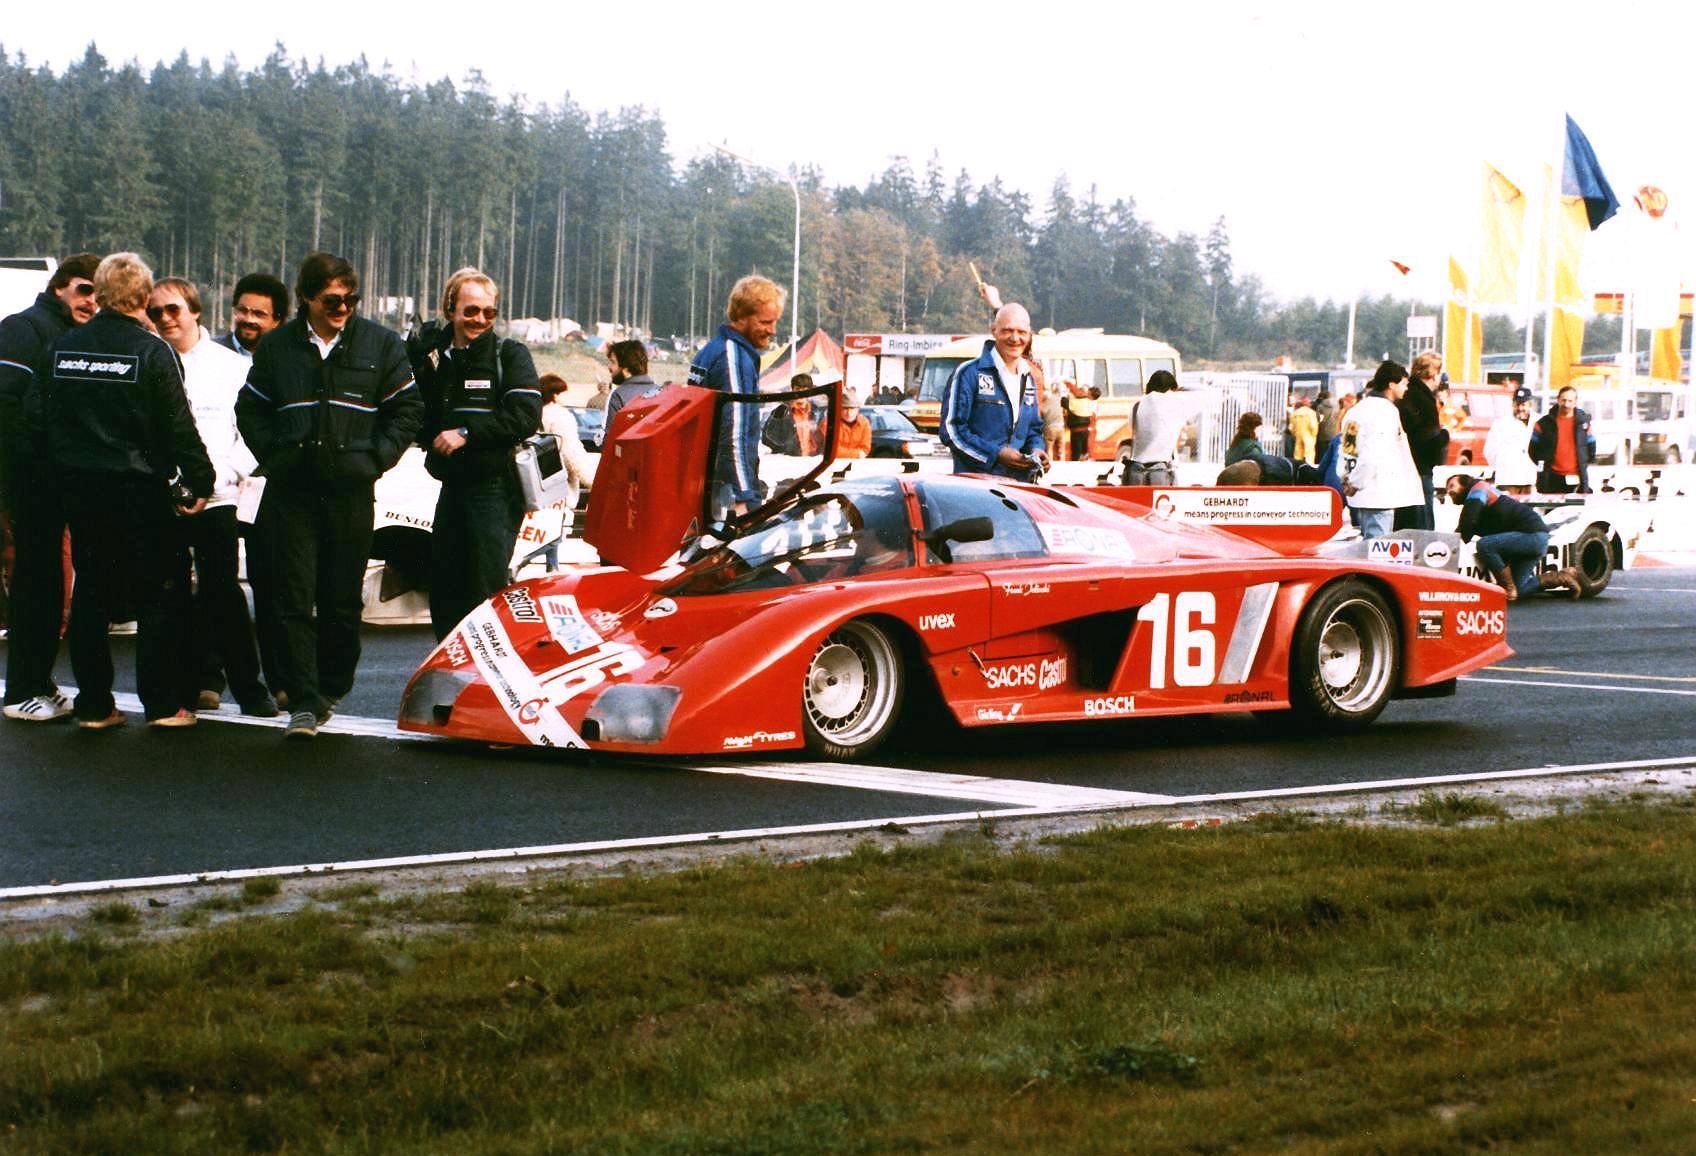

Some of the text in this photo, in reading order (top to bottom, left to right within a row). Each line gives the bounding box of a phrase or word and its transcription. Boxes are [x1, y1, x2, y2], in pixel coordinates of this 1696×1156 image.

[1203, 497, 1249, 507] GEBHARDT
[385, 511, 433, 528] DUNLO
[1210, 511, 1244, 521] progress
[1245, 511, 1251, 519] in
[1252, 512, 1286, 520] conveyor
[1288, 509, 1329, 520] technology
[1371, 541, 1413, 558] AVON
[919, 613, 956, 631] uvex
[1456, 610, 1504, 635] SACHS
[481, 622, 508, 658] GEBHARDT
[1137, 591, 1216, 689] 16
[986, 663, 1036, 688] SACHS
[1084, 696, 1135, 715] BOSCH
